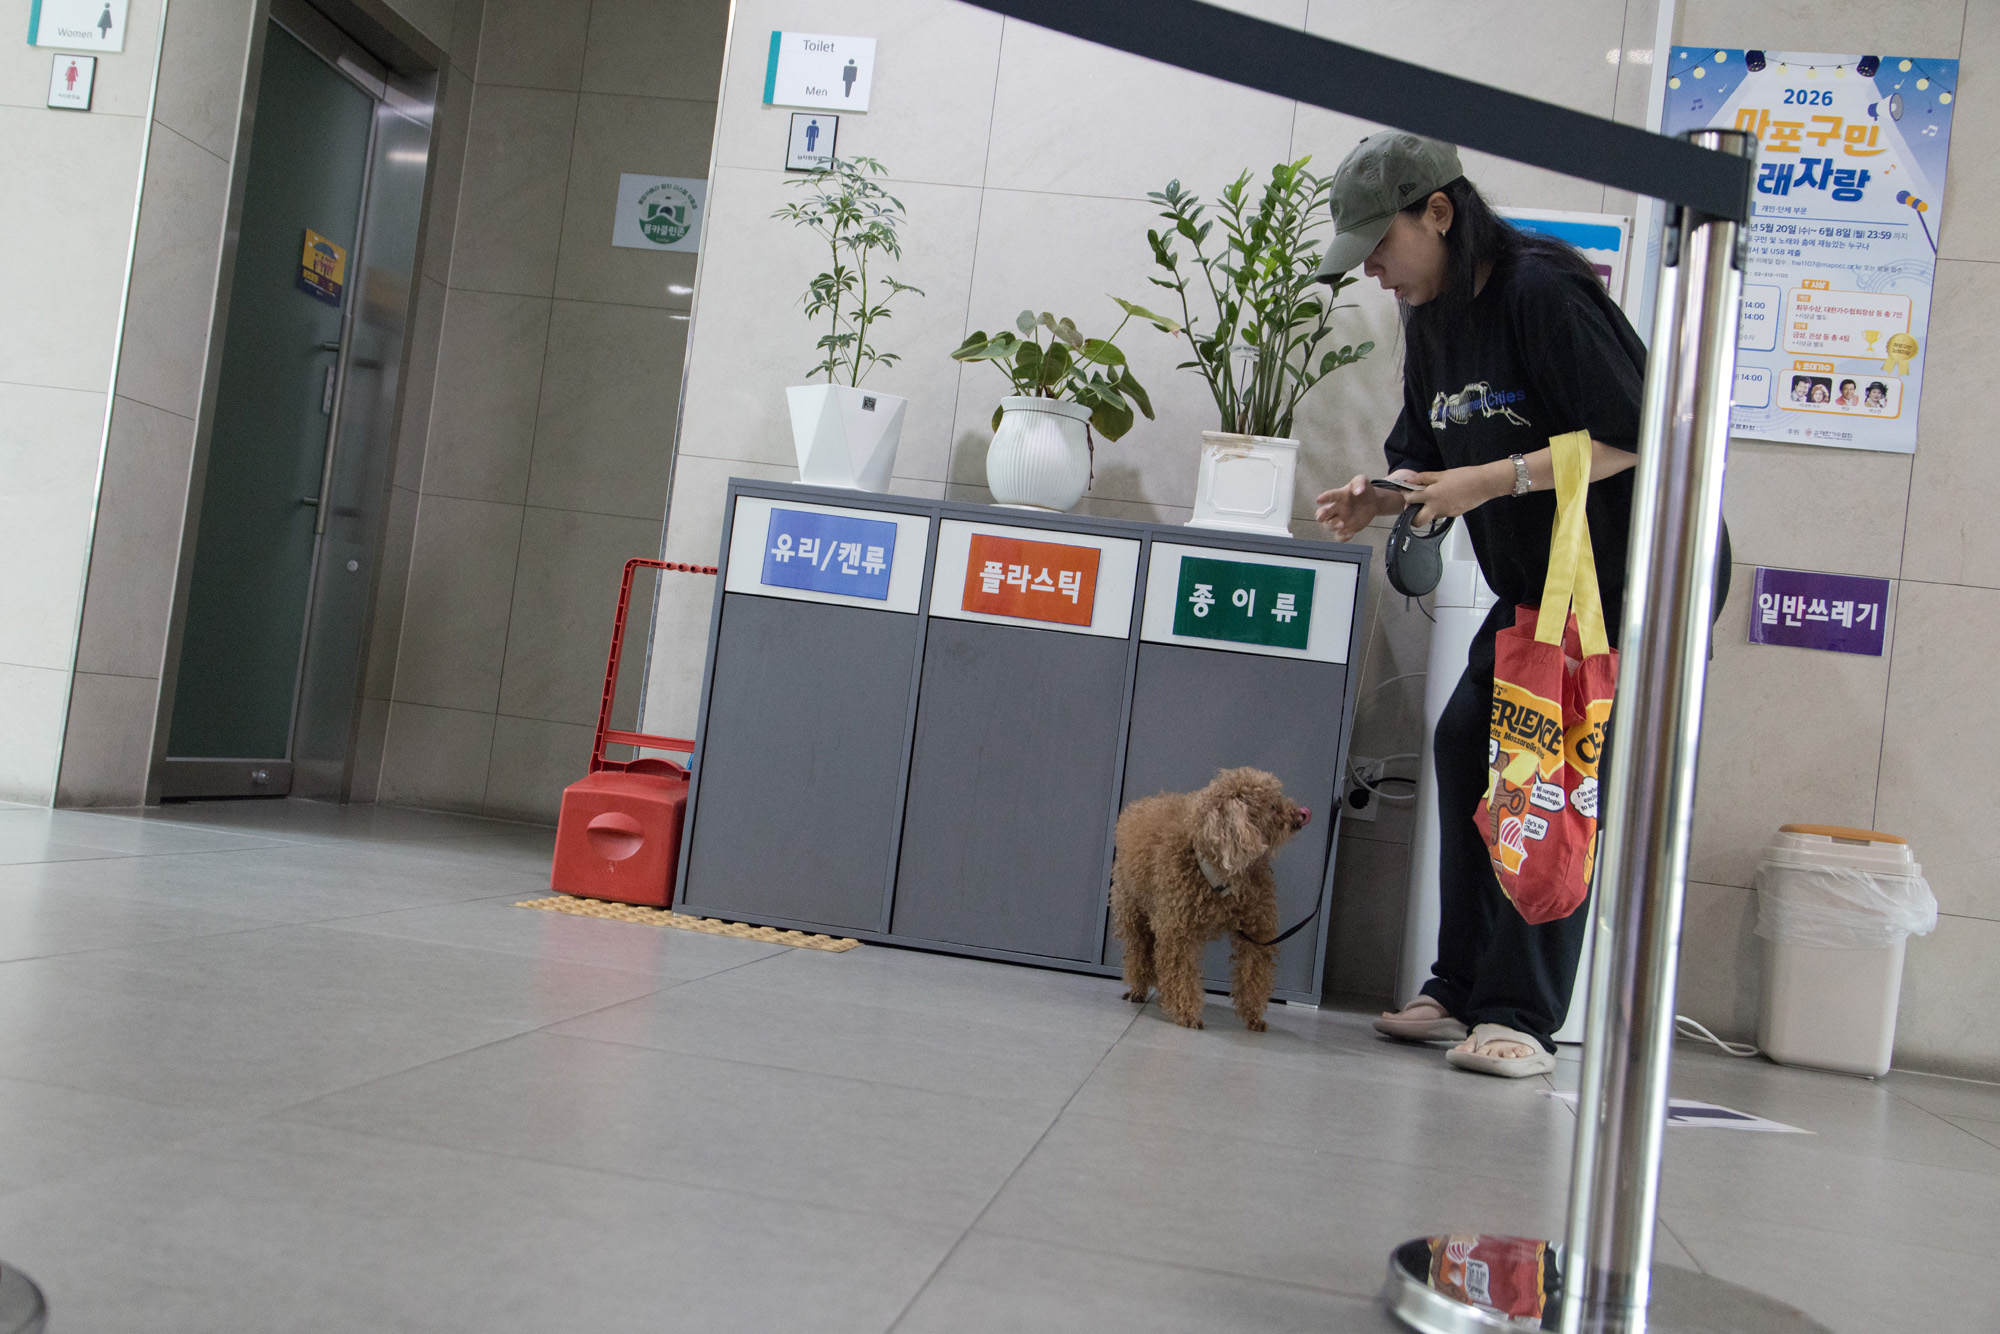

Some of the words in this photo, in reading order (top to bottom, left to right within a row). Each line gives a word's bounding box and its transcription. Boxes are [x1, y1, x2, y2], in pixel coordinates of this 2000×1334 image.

[58, 27, 93, 39] Women
[803, 39, 835, 53] Toilet
[805, 86, 828, 97] Men
[1783, 88, 1834, 107] 2026
[1734, 108, 1888, 157] 마포구민
[1756, 157, 1871, 202] 래자랑
[1760, 223, 1774, 234] 5월
[1775, 225, 1797, 235] 20일
[1818, 227, 1834, 237] 6월
[1836, 228, 1851, 238] 8일
[1867, 230, 1892, 240] 23:59
[1779, 238, 1800, 246] 노래와
[1848, 242, 1870, 250] 누구나
[1770, 248, 1785, 256] USB
[1745, 301, 1766, 309] 14:00
[1744, 313, 1765, 321] 14:00
[1741, 374, 1763, 382] 14:00
[1487, 389, 1526, 407] Cities
[771, 533, 886, 576] 유리/캔류
[979, 560, 1082, 604] 플라스틱
[1758, 593, 1879, 631] 일반쓰레기
